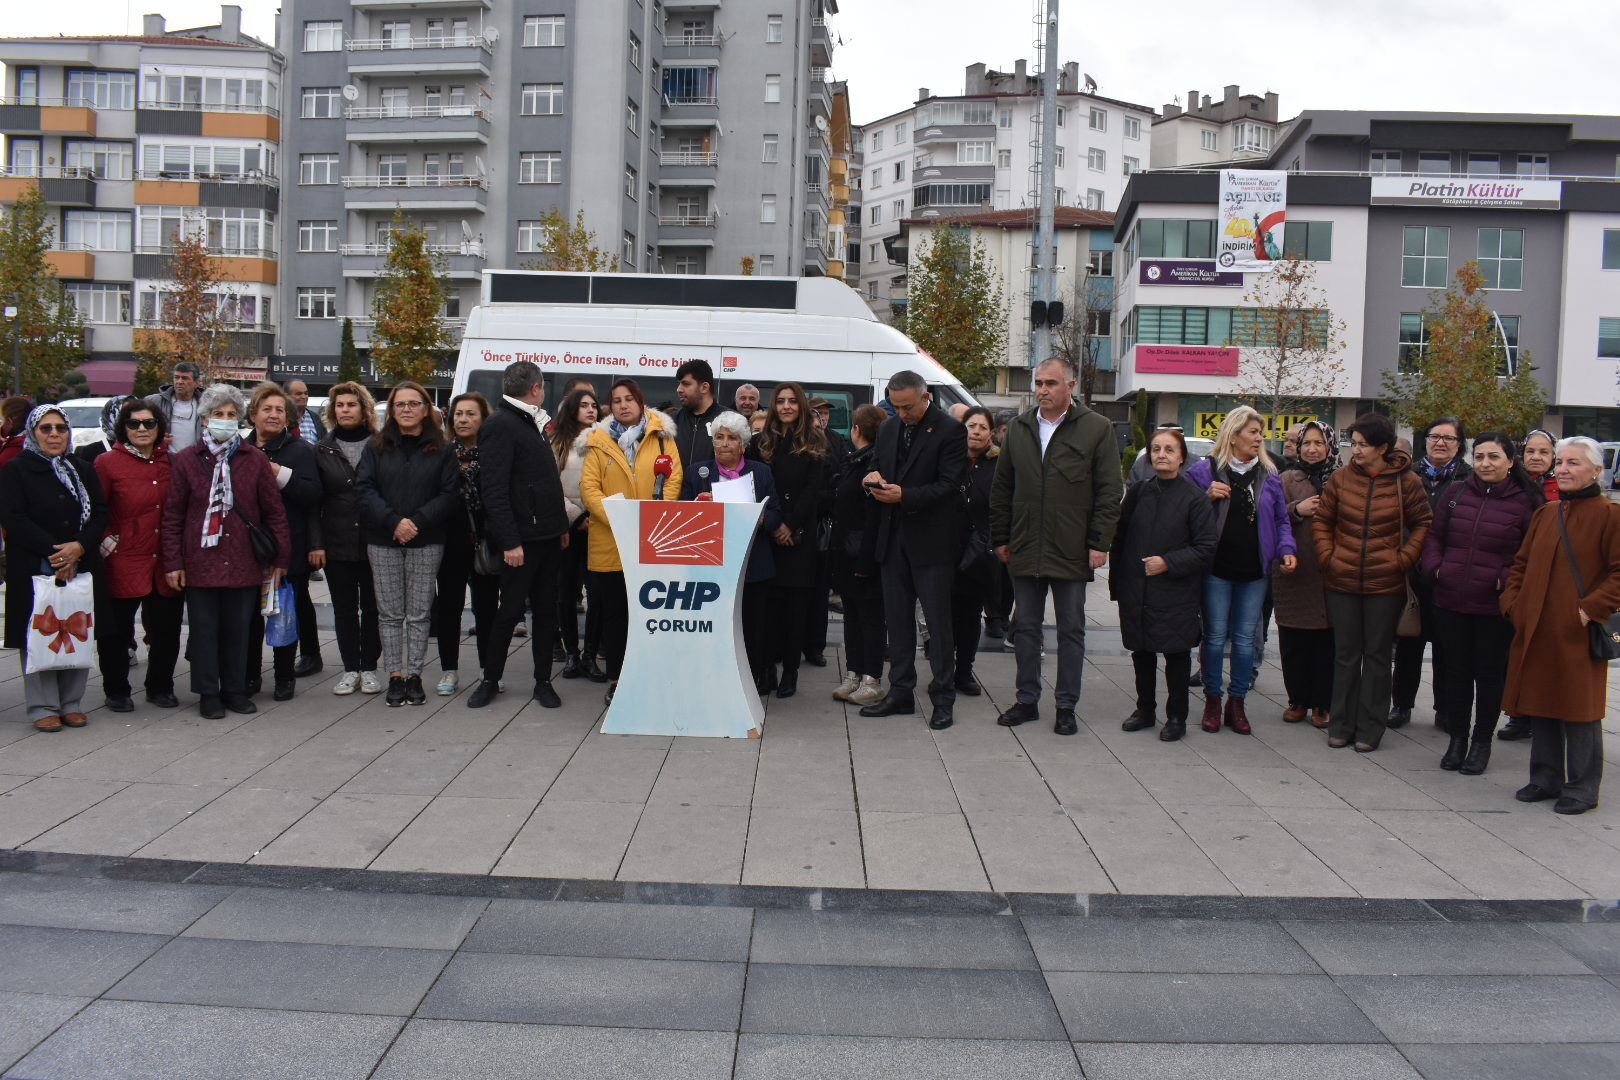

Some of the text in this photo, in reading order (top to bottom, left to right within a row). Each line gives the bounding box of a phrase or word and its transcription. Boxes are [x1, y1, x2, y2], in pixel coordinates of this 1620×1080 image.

[1408, 182, 1524, 198] Platin Kültür
[1222, 240, 1257, 251] İNDİRİM
[563, 352, 592, 364] Önce
[595, 355, 629, 368] insan,
[638, 354, 668, 367] Önce
[638, 579, 720, 610] CHP
[646, 619, 713, 634] ÇORUM
